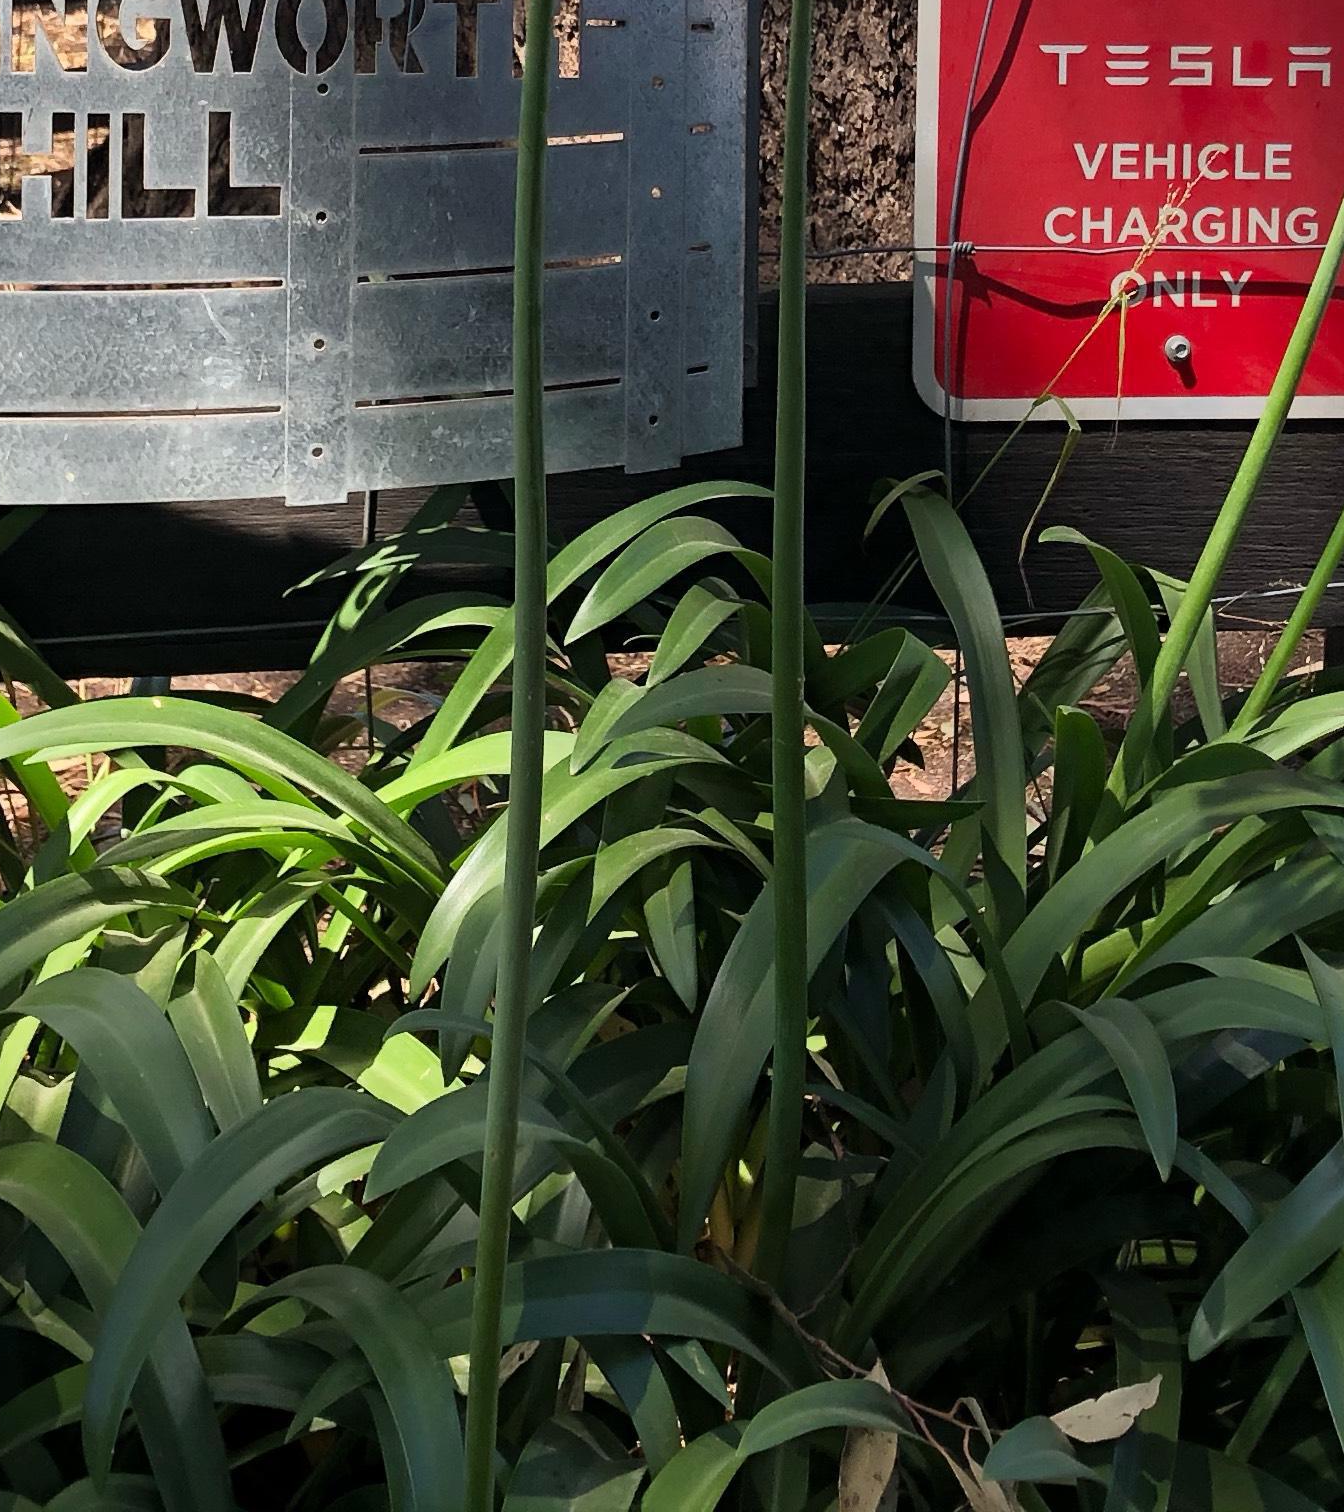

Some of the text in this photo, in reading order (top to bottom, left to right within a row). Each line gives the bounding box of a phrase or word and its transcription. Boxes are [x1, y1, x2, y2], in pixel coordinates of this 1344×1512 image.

[1038, 44, 1333, 87] TESLA
[1072, 142, 1293, 181] VEHICLE
[1043, 206, 1320, 245] CHARGING
[1110, 270, 1253, 309] ONLY
